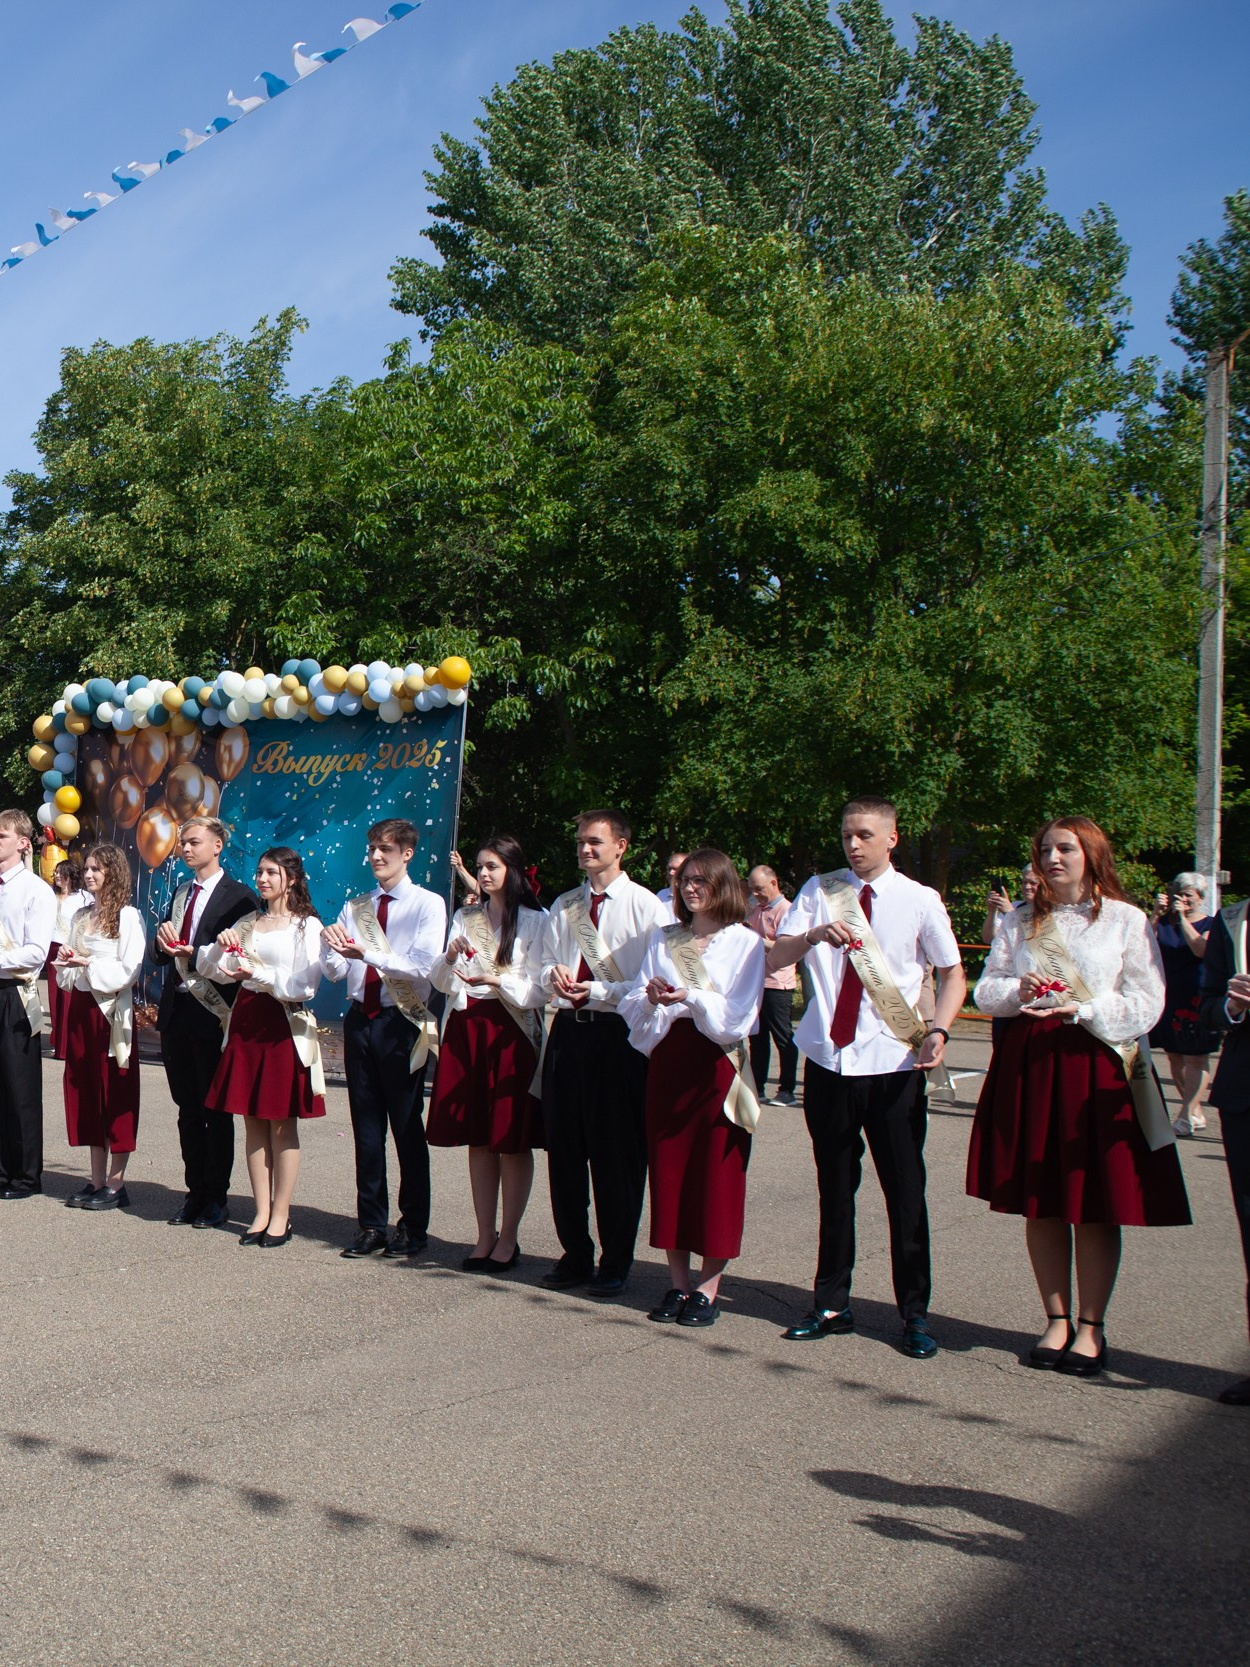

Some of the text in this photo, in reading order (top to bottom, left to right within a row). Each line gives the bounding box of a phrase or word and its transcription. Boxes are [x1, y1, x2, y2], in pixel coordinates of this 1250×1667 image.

[252, 739, 448, 787] Выпуск 2025
[882, 996, 916, 1030] 2025
